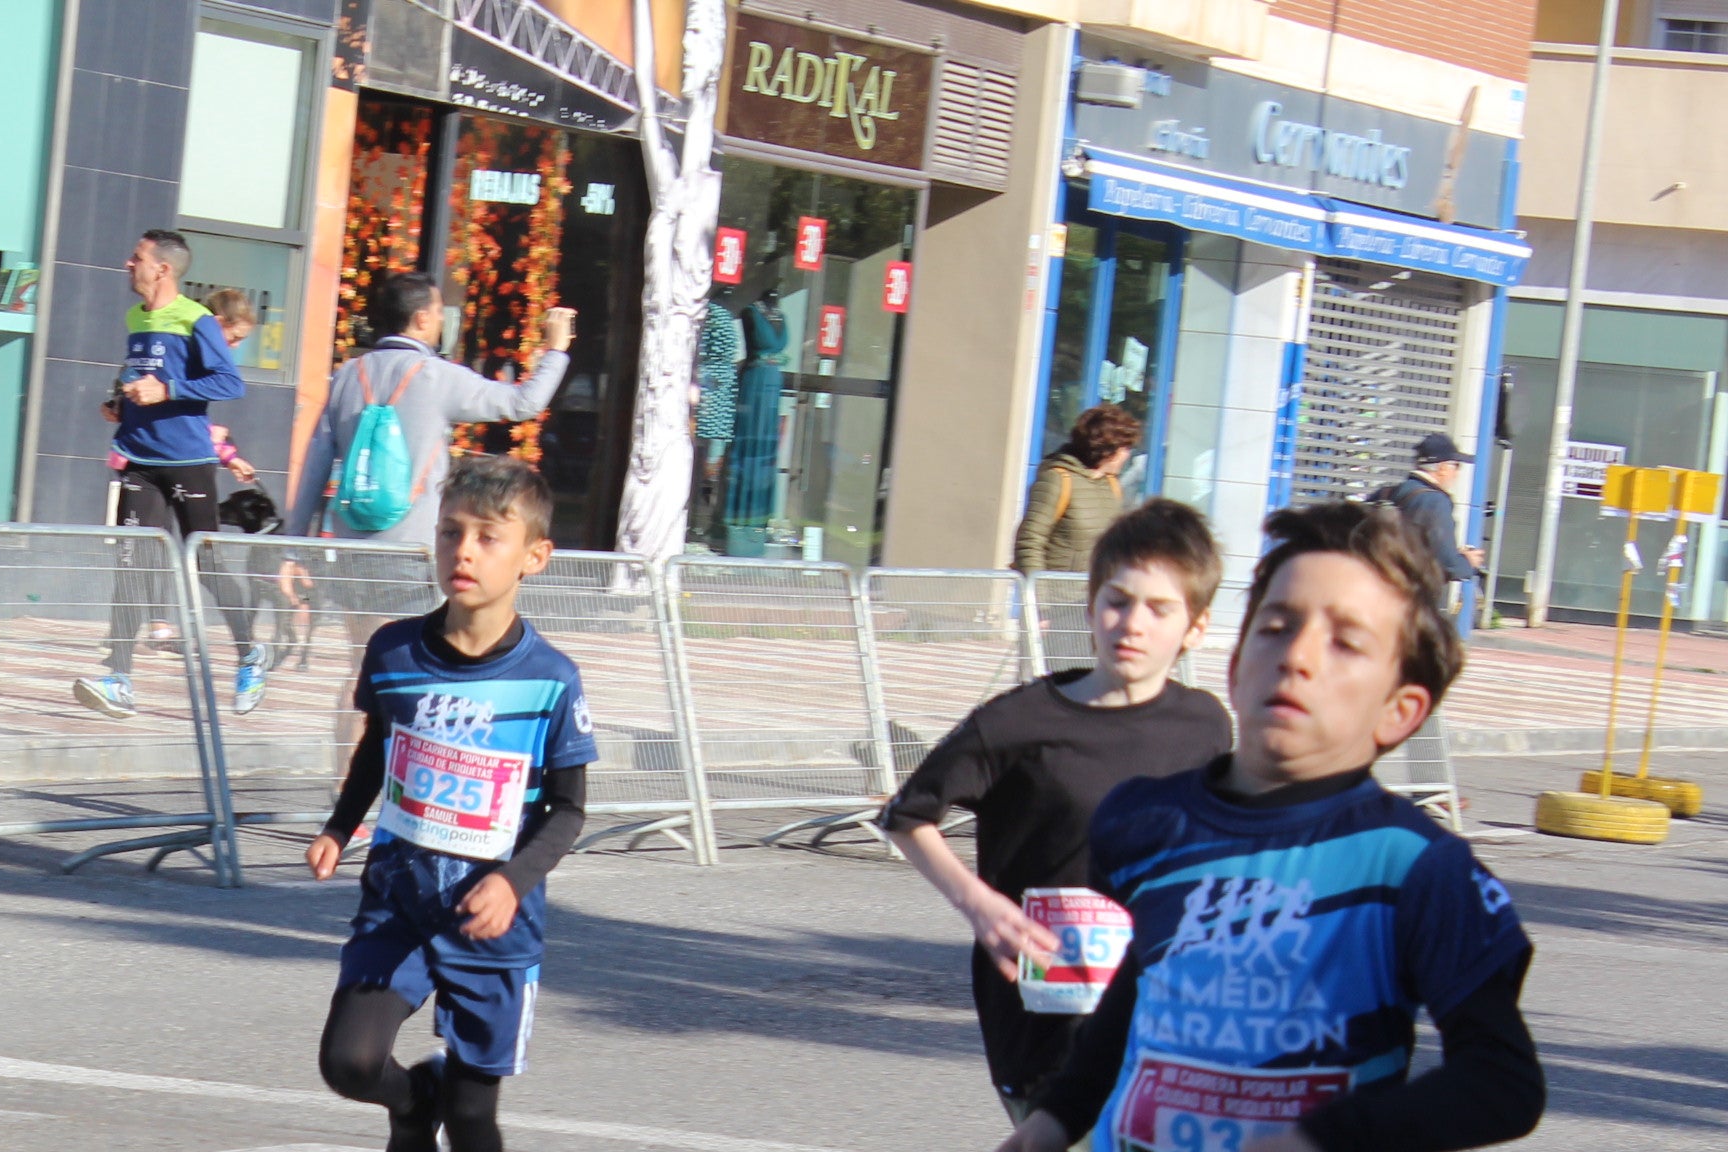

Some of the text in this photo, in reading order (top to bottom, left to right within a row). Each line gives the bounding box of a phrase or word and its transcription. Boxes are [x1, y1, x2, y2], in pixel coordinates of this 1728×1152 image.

[742, 41, 901, 150] RADIKAL
[1251, 101, 1411, 189] Cervantes
[407, 750, 494, 780] CIUDAD DE ROQUETAS
[421, 741, 459, 760] CARRERA
[459, 752, 500, 768] POPULAR
[412, 767, 484, 811] 925
[423, 805, 460, 825] SAMUEL
[1180, 973, 1328, 1011] MEDIA
[1137, 1011, 1349, 1054] MARATON
[1179, 1068, 1238, 1095] CARRERA
[1240, 1079, 1308, 1097] POPULAR
[1202, 1095, 1221, 1112] DE
